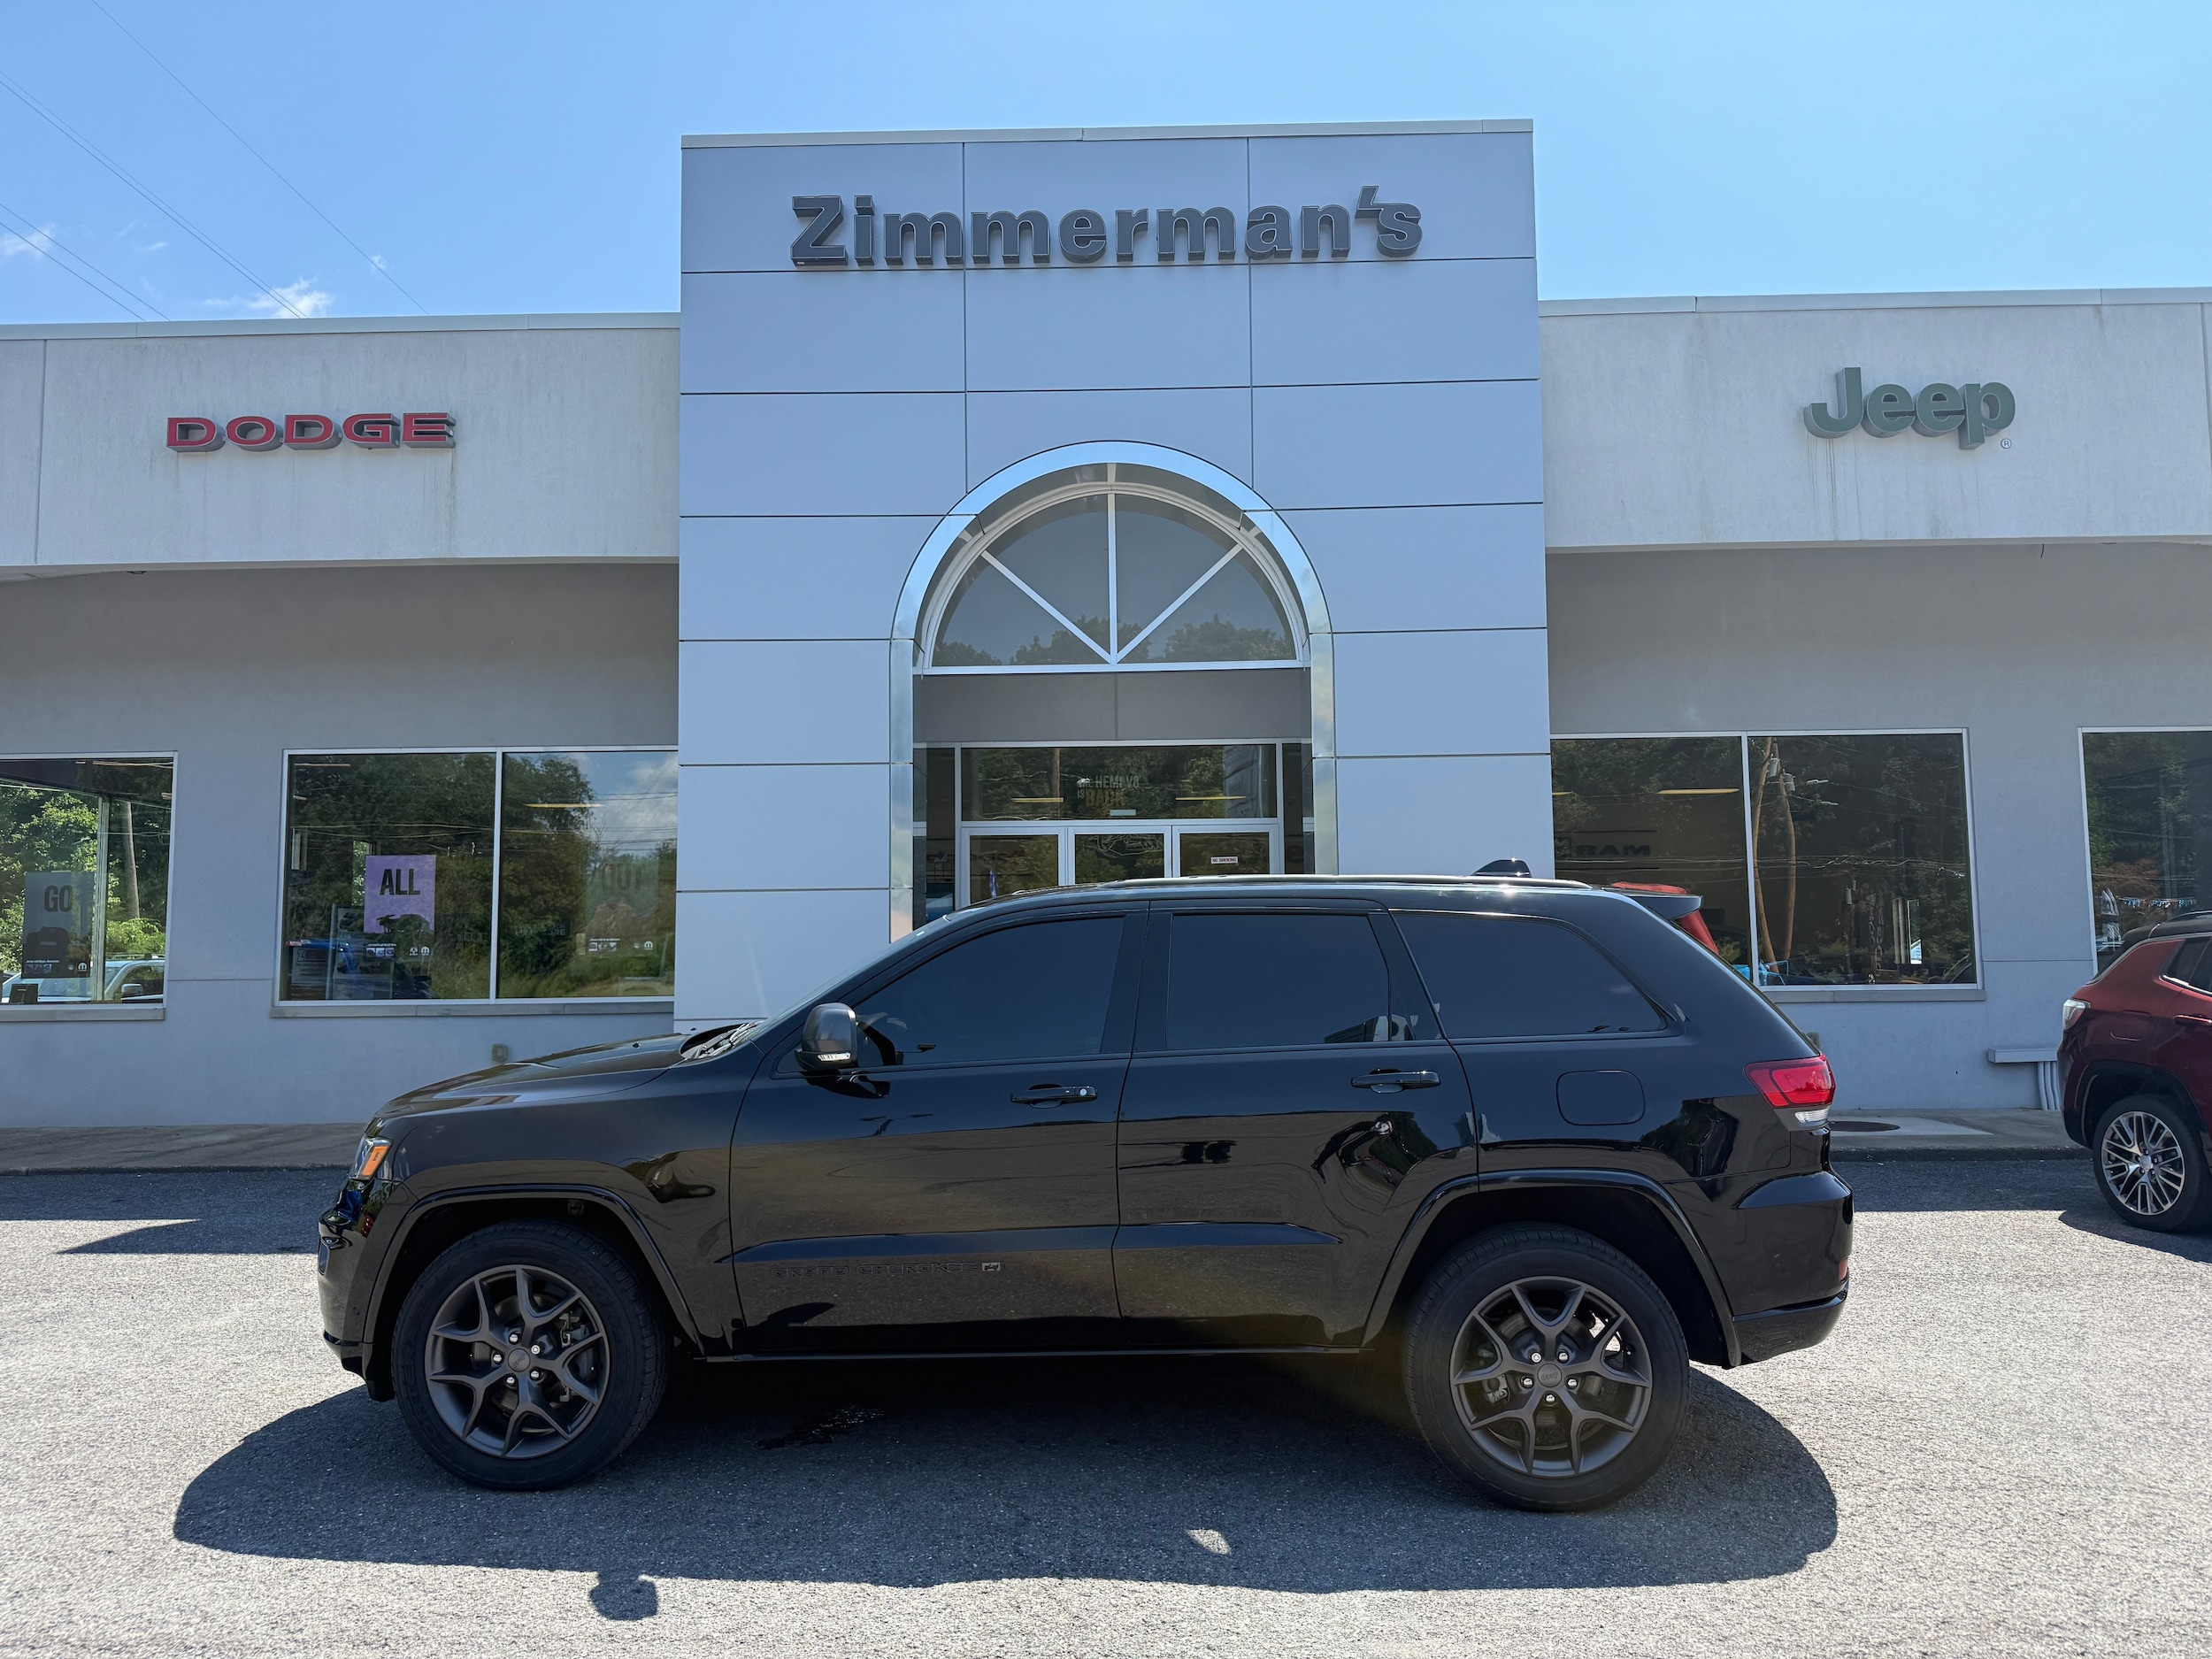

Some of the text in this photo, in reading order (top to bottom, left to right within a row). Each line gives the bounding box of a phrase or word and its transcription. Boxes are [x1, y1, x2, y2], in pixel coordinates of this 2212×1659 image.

[790, 185, 1423, 267] Zimmerman's
[1803, 366, 2016, 449] Jeep
[166, 411, 456, 452] DODGE
[1095, 775, 1122, 788] HEMI
[1575, 844, 1650, 856] RAM
[380, 868, 420, 895] ALL
[44, 885, 73, 912] GO
[856, 1261, 979, 1276] CHEROKEE
